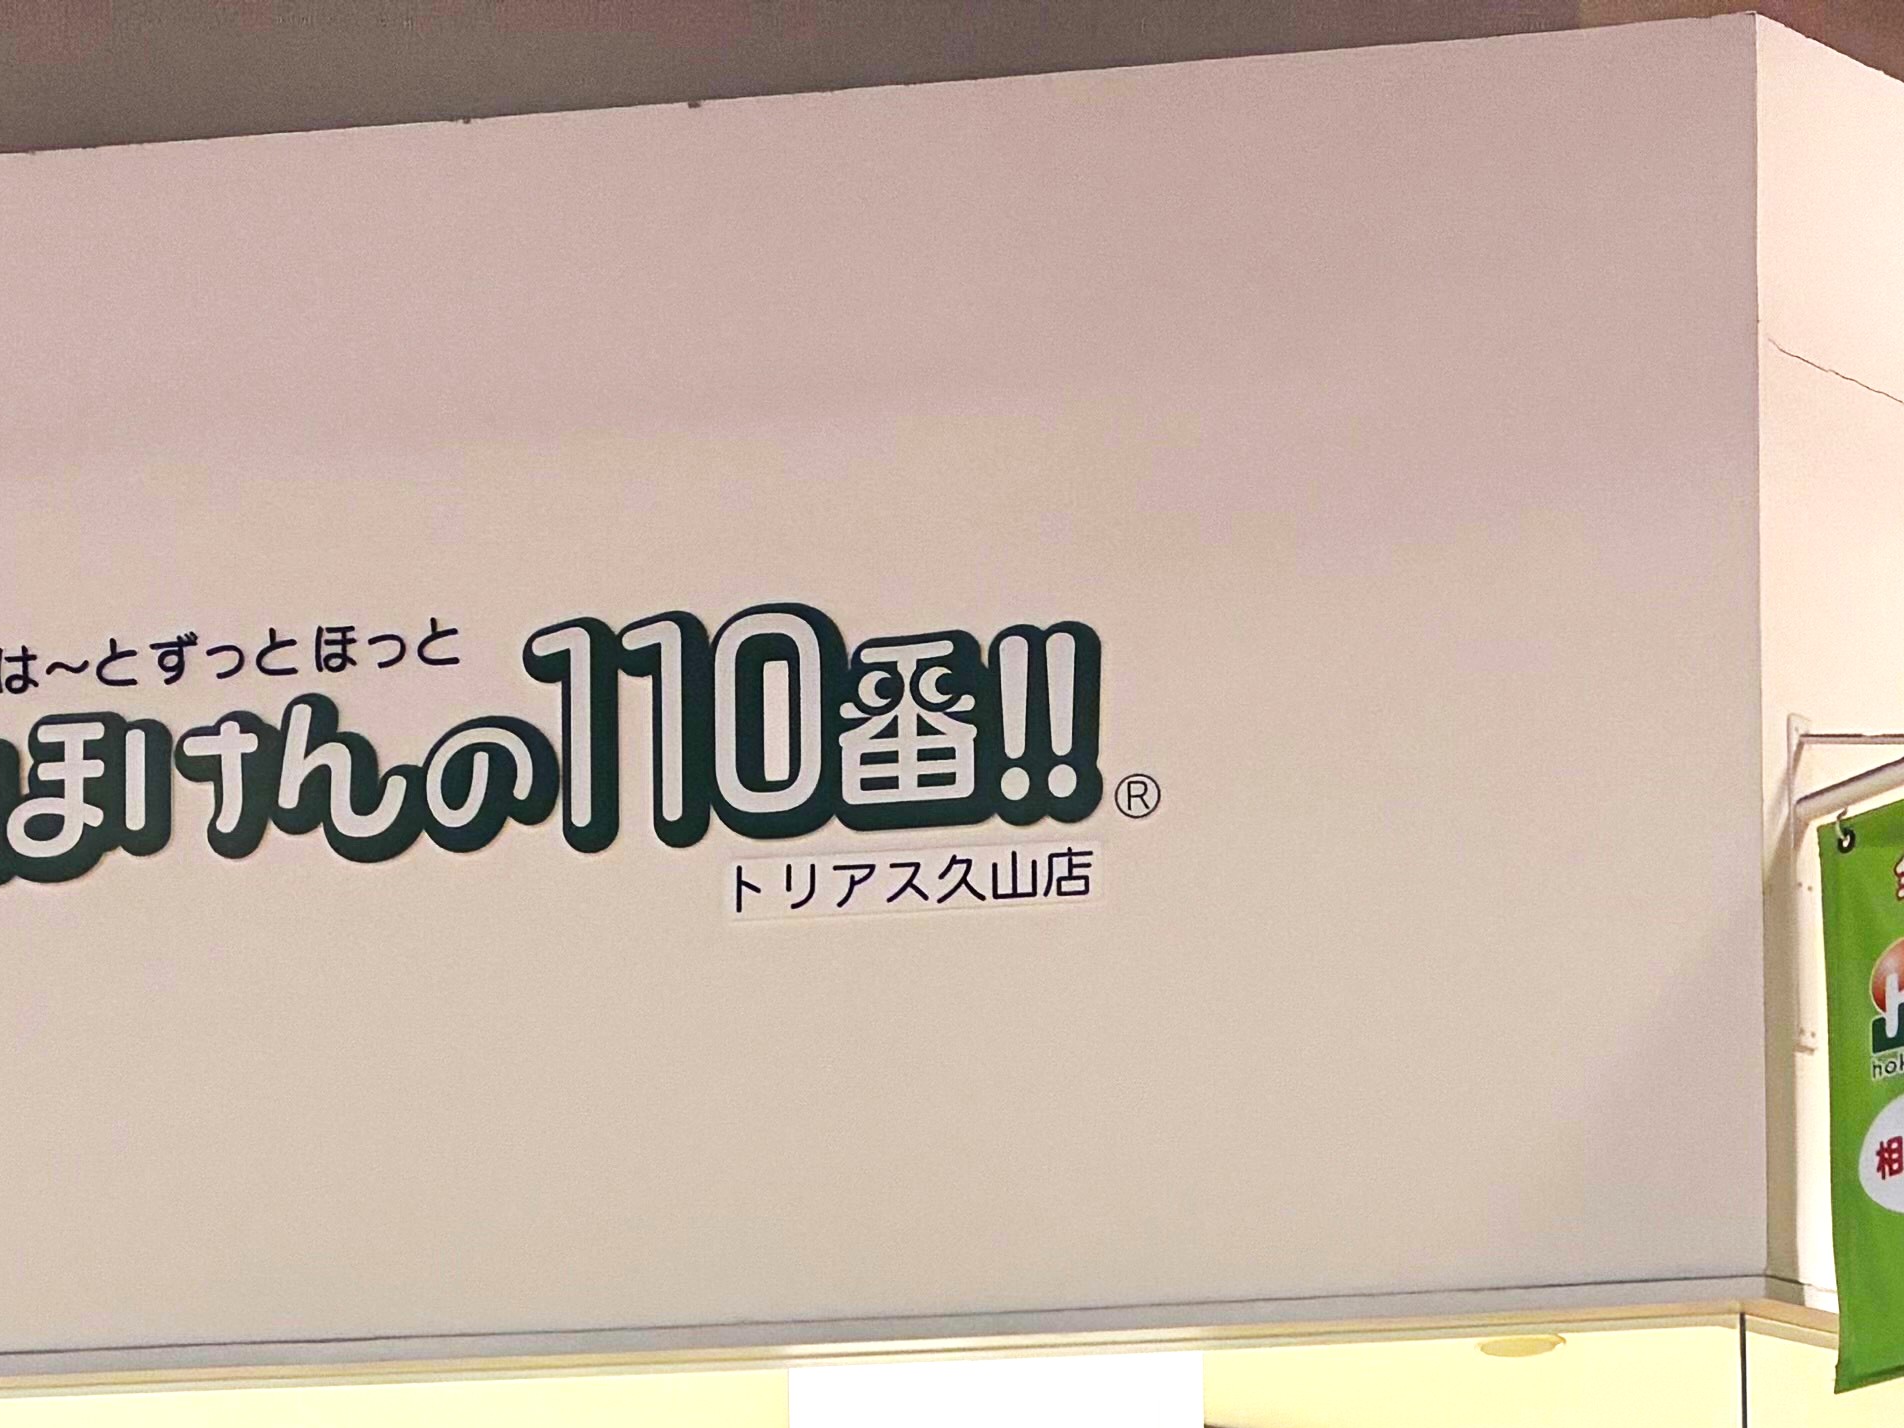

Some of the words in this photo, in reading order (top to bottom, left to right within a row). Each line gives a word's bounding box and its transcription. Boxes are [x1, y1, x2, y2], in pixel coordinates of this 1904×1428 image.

[729, 846, 1095, 913] トリアス久山店
